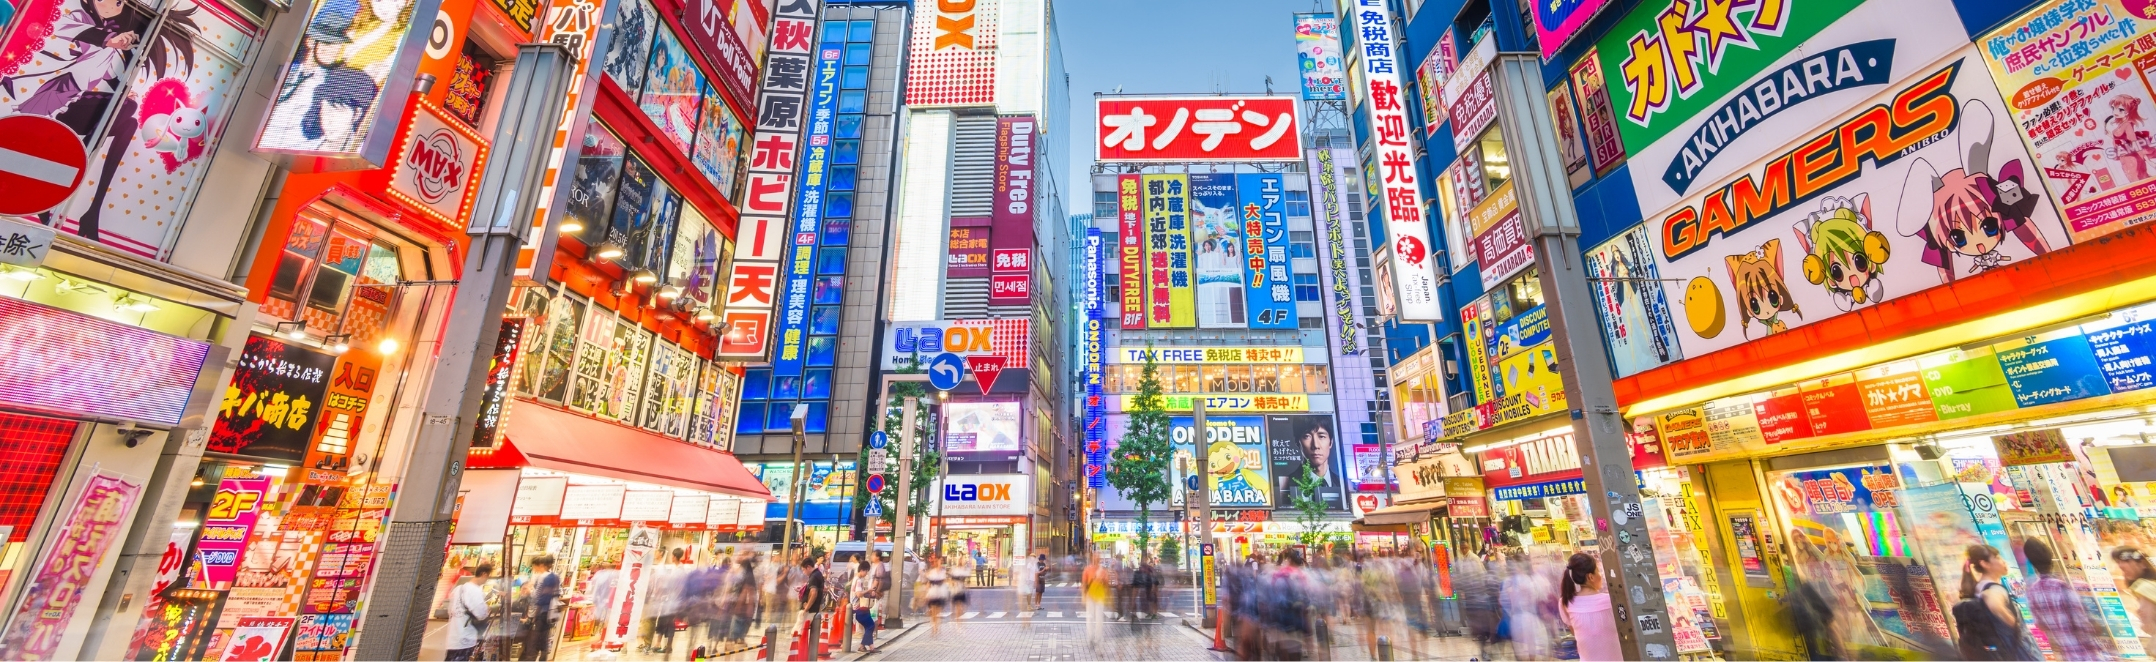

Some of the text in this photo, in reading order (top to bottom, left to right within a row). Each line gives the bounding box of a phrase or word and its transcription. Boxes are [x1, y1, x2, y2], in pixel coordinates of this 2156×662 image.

[1360, 11, 1393, 74] 免税商店
[717, 29, 752, 93] Doll Point
[1682, 49, 1863, 178] AKIHABARA
[1103, 100, 1292, 152] オノデン
[1901, 129, 1949, 157] ANIBRO
[998, 122, 1010, 192] Flagship Store
[1662, 64, 1957, 260] GAMERS
[1008, 122, 1032, 214] Duty Free
[1121, 179, 1139, 211] 免税
[2135, 200, 2156, 211] 583
[951, 229, 970, 238] 本店
[996, 253, 1027, 268] 免税
[994, 281, 1027, 293] 면세점
[1088, 235, 1100, 385] Panasonic ONODEN
[1163, 350, 1203, 361] FREE
[1500, 340, 1509, 356] 2F
[892, 356, 914, 364] Hom
[974, 363, 999, 372] 止まれ
[335, 362, 375, 392] 入口
[1213, 380, 1277, 392] MODFY
[327, 392, 367, 412] はコチラ
[1206, 398, 1250, 409] エアコン
[1493, 394, 1521, 412] DISCOUNT
[1504, 404, 1531, 419] MOBILES
[209, 491, 259, 519] 2F
[1872, 492, 1897, 508] OPE
